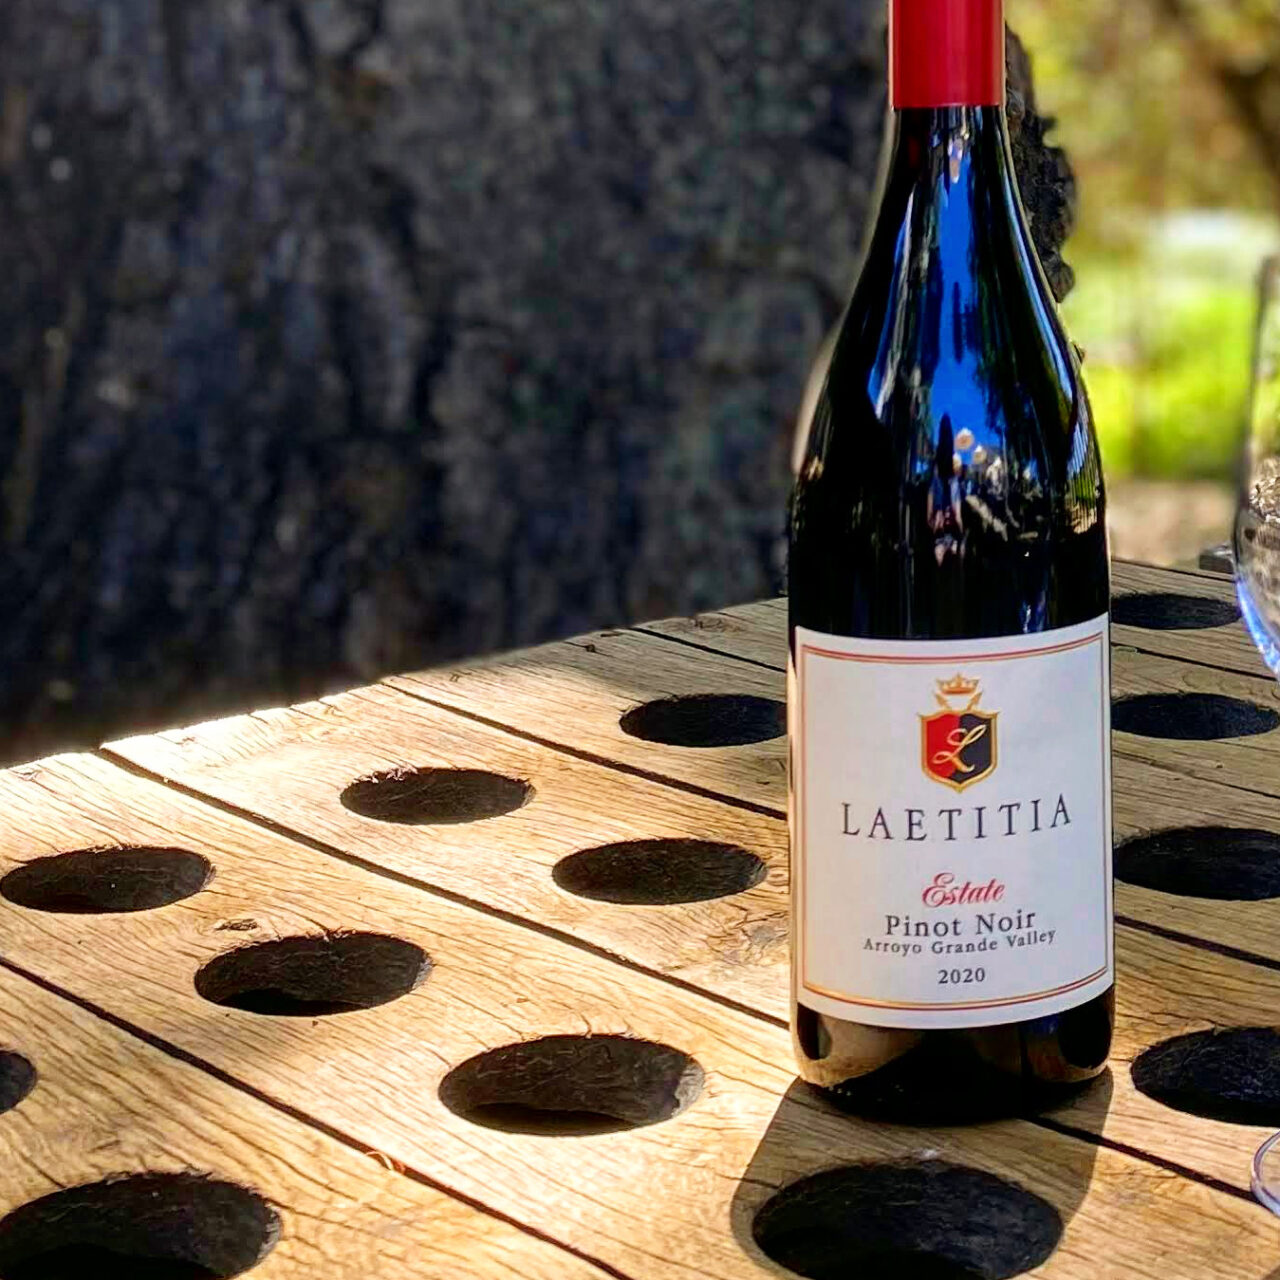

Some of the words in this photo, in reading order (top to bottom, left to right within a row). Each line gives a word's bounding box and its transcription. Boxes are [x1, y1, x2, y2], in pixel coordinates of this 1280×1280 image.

[842, 793, 1073, 842] LAETITIA
[921, 872, 1006, 909] Estate
[885, 913, 962, 937] Pinot
[976, 910, 1037, 934] Noir
[863, 938, 923, 957] Arroyo
[931, 938, 999, 955] Grande
[1008, 928, 1057, 947] Valley
[937, 967, 986, 985] 2020
